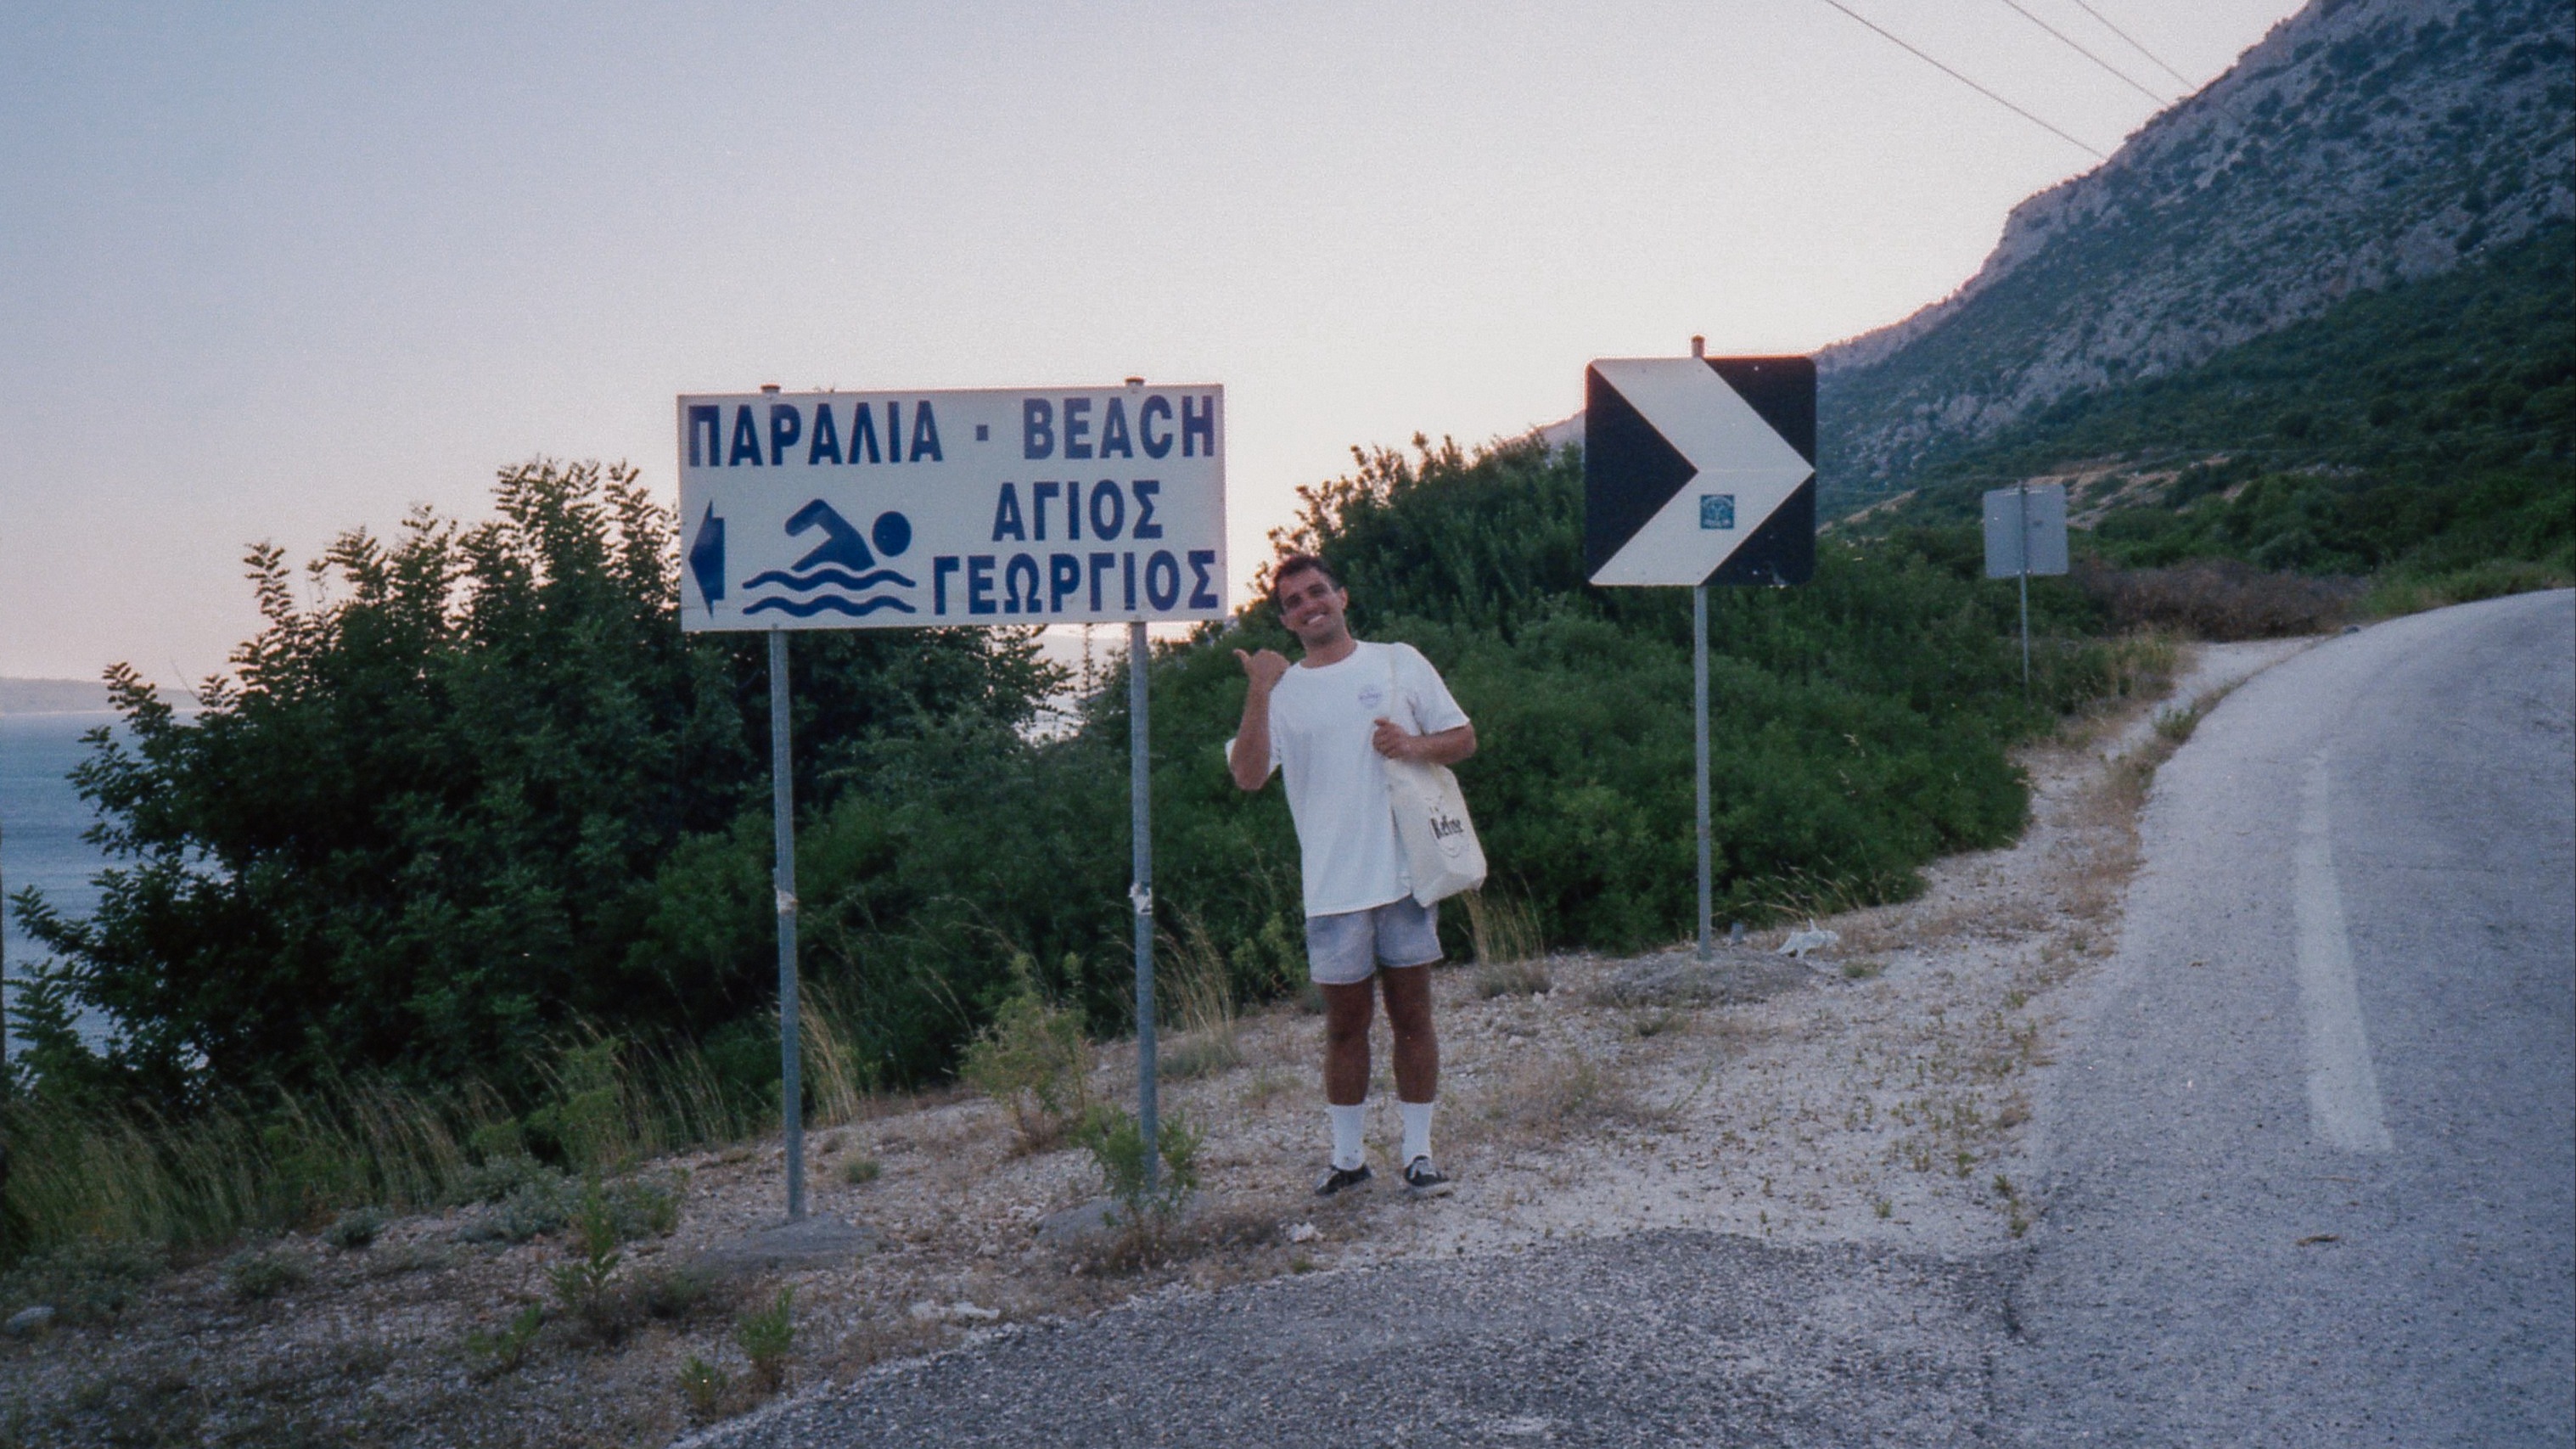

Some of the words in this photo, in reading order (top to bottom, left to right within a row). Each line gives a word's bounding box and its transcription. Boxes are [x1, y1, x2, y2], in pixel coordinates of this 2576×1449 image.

[687, 401, 944, 468] ΠΑΡΑΛΙΑ
[1022, 395, 1215, 461] BEACH
[991, 479, 1164, 542] ΑΓΙΟΣ
[933, 549, 1220, 616] ΓΕΩΡΓΙΟΣ
